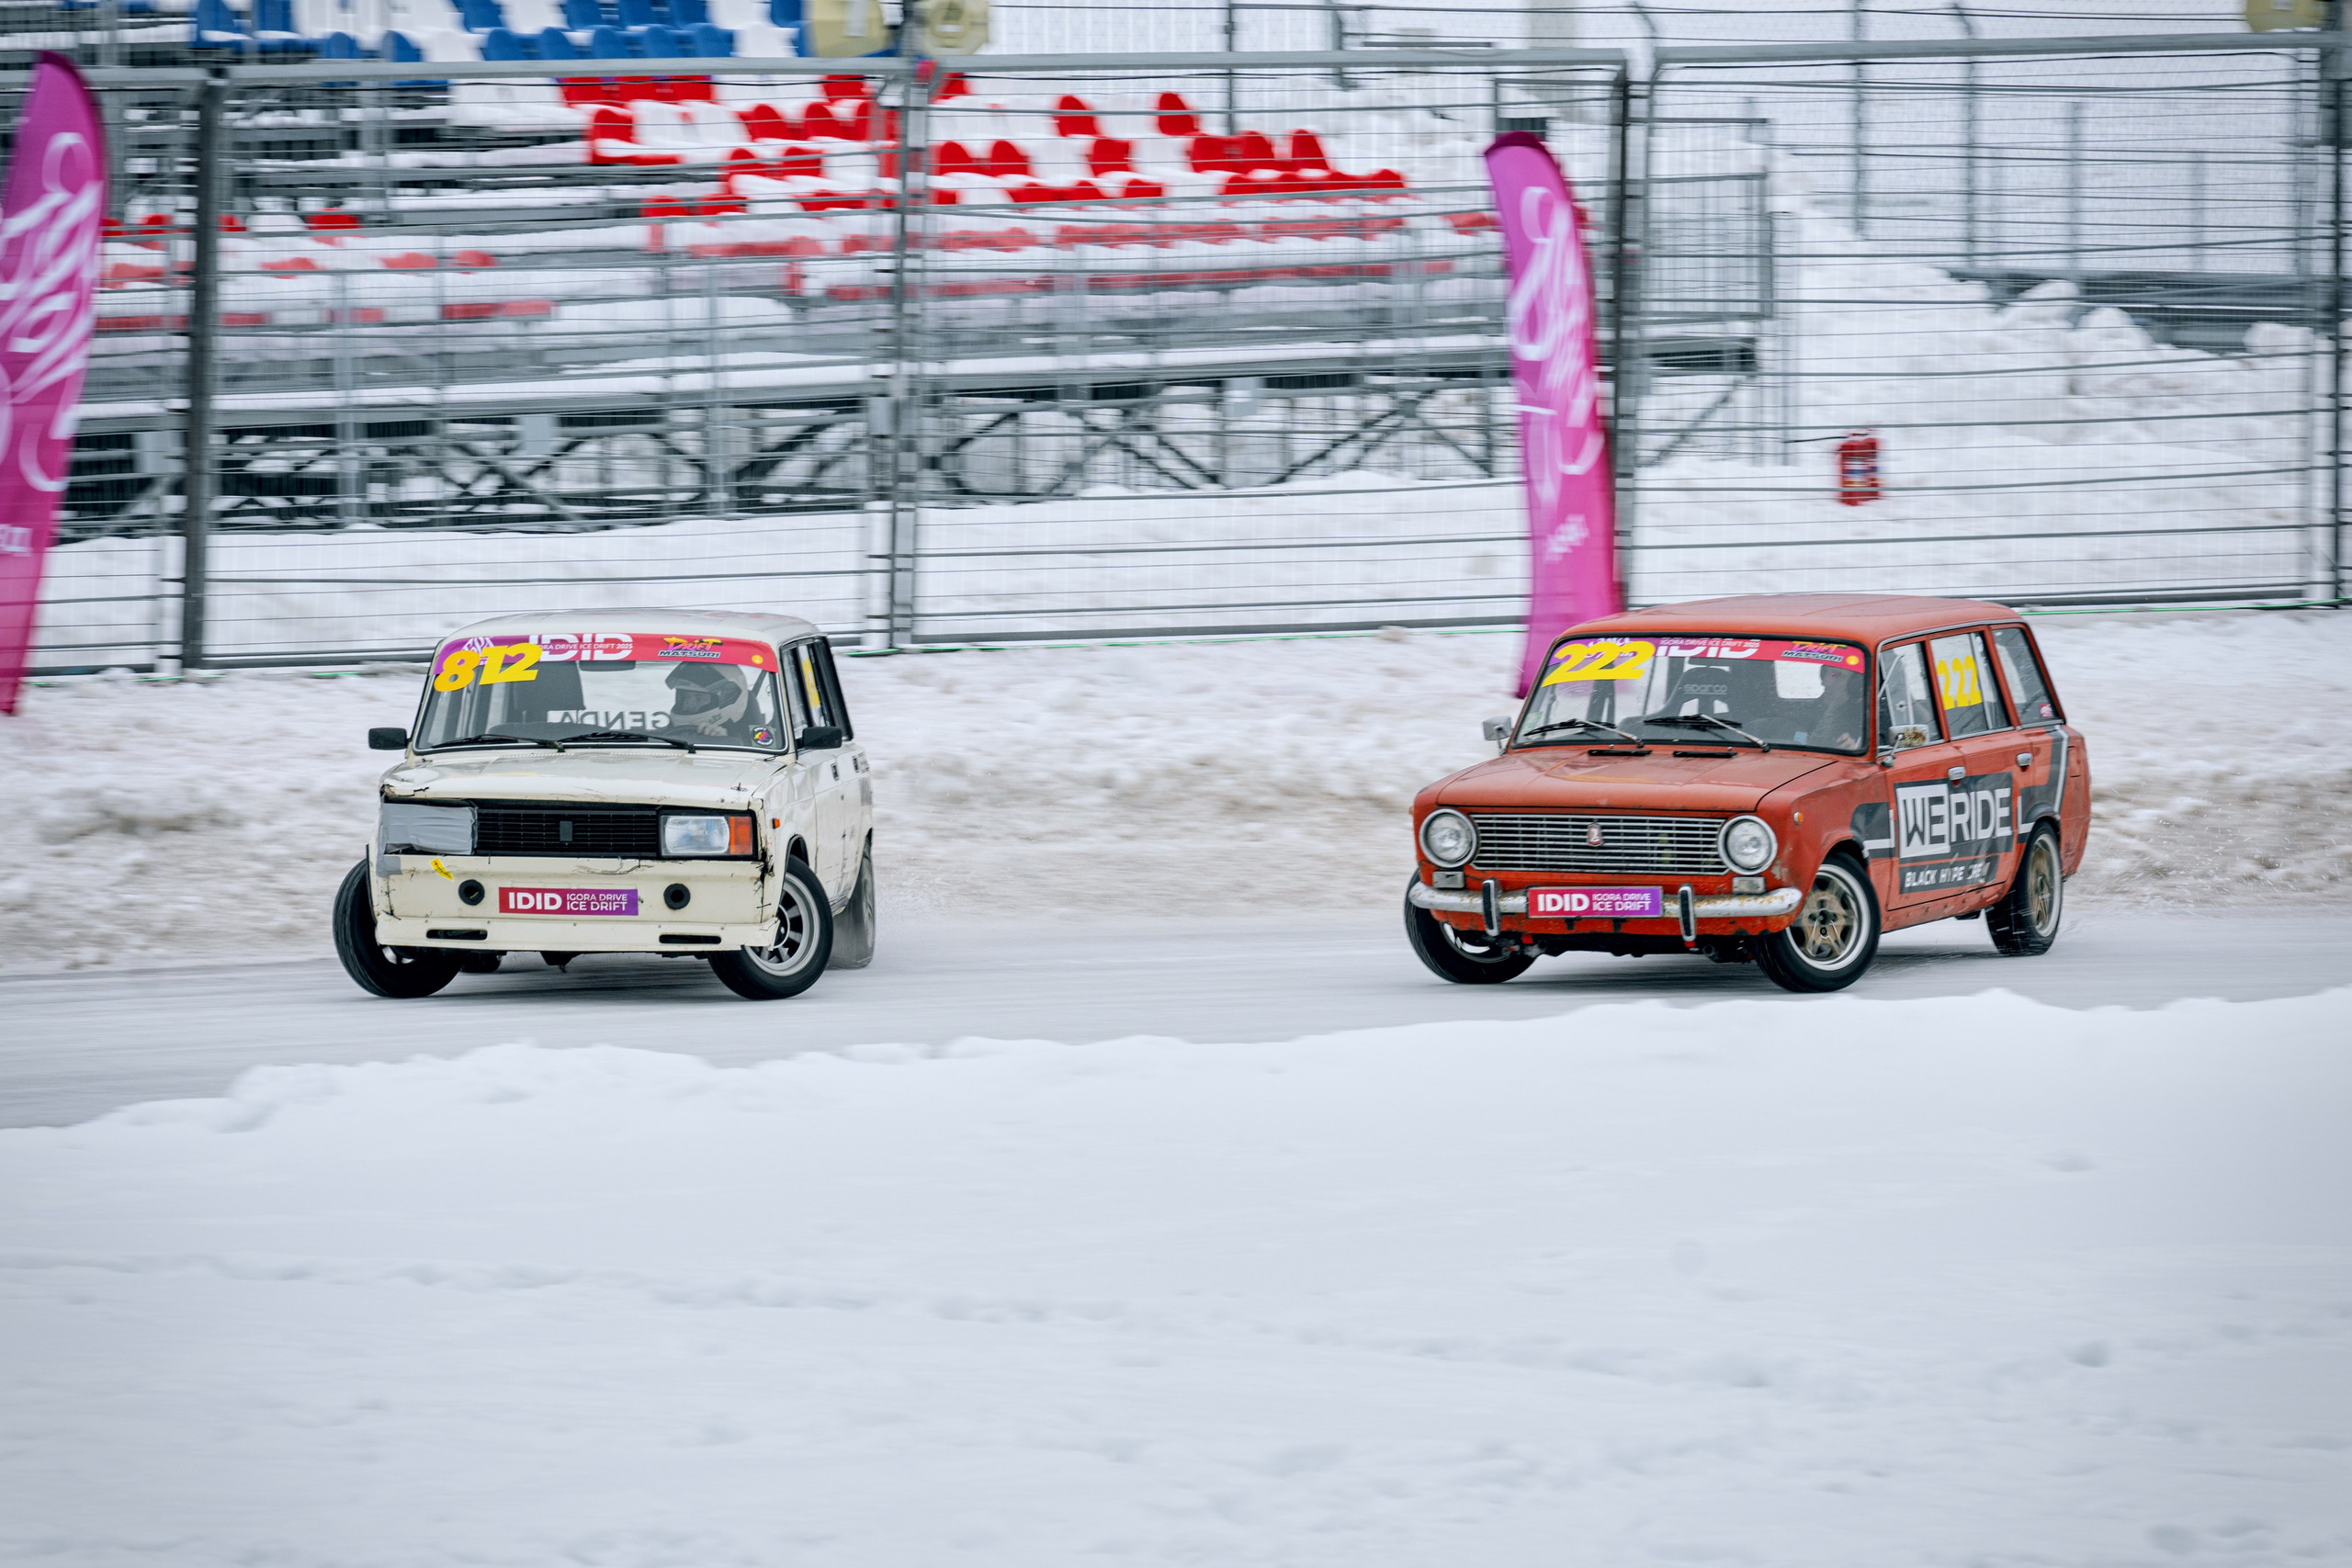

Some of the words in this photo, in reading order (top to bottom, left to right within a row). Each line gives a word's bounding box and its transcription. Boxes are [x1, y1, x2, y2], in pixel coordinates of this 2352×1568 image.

[658, 650, 721, 659] MATSURI
[433, 642, 543, 693] 812
[1541, 640, 1656, 688] 222
[1683, 683, 1728, 694] sparco
[1936, 654, 1984, 711] 222
[1904, 869, 1939, 888] BLACK
[508, 892, 563, 910] IDID
[566, 893, 596, 901] IGORA
[1537, 893, 1590, 912] IDID
[1592, 893, 1623, 901] IGORA
[1622, 893, 1652, 901] DRIVE
[566, 901, 587, 910] ICE
[590, 902, 628, 911] DRIFT
[1592, 901, 1613, 911] ICE
[1614, 901, 1652, 911] DRIFT
